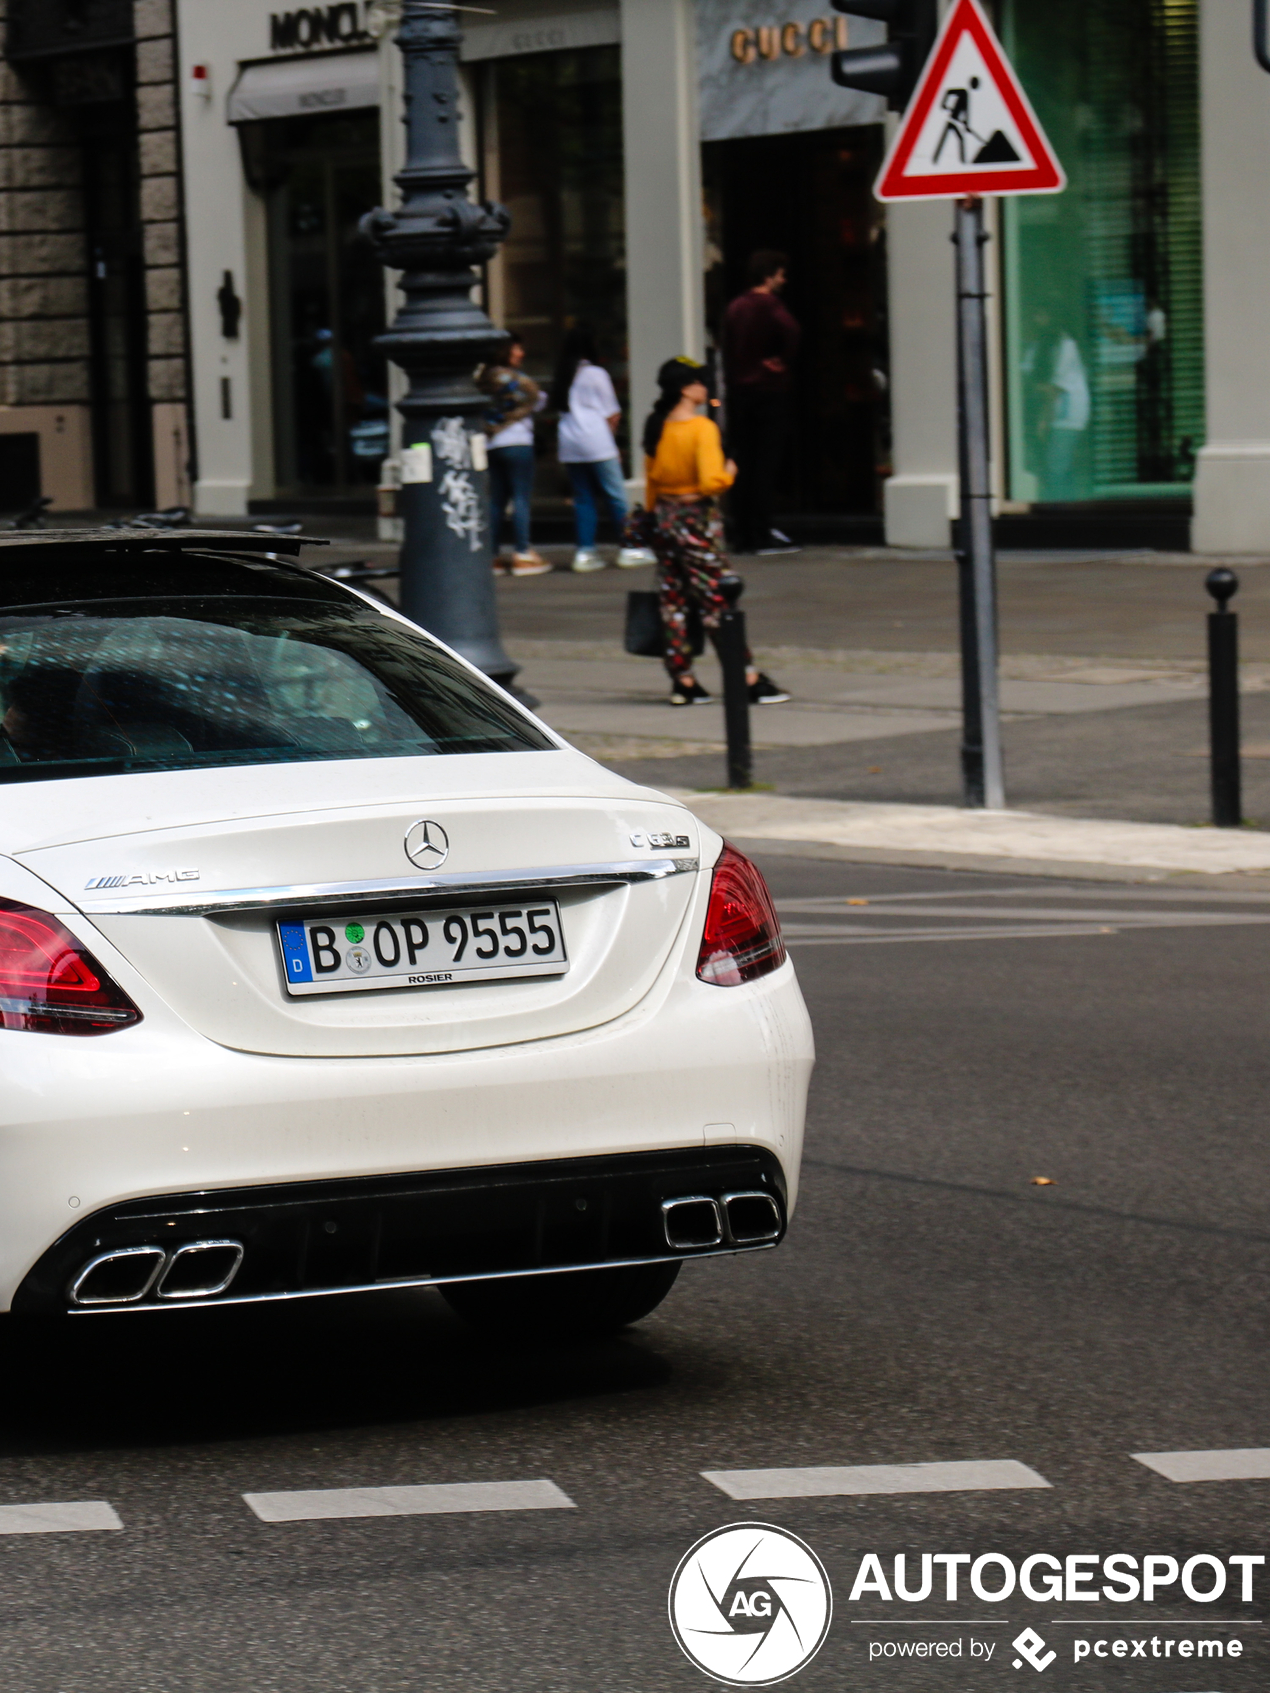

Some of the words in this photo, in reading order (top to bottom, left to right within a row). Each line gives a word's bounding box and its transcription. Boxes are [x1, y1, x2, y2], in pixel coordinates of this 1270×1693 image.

[732, 15, 848, 64] GUCCI
[121, 867, 200, 887] AMG
[309, 926, 341, 974] B
[373, 917, 429, 968] OP
[443, 908, 555, 962] 9555
[292, 959, 303, 972] D
[408, 973, 453, 984] ROSIER
